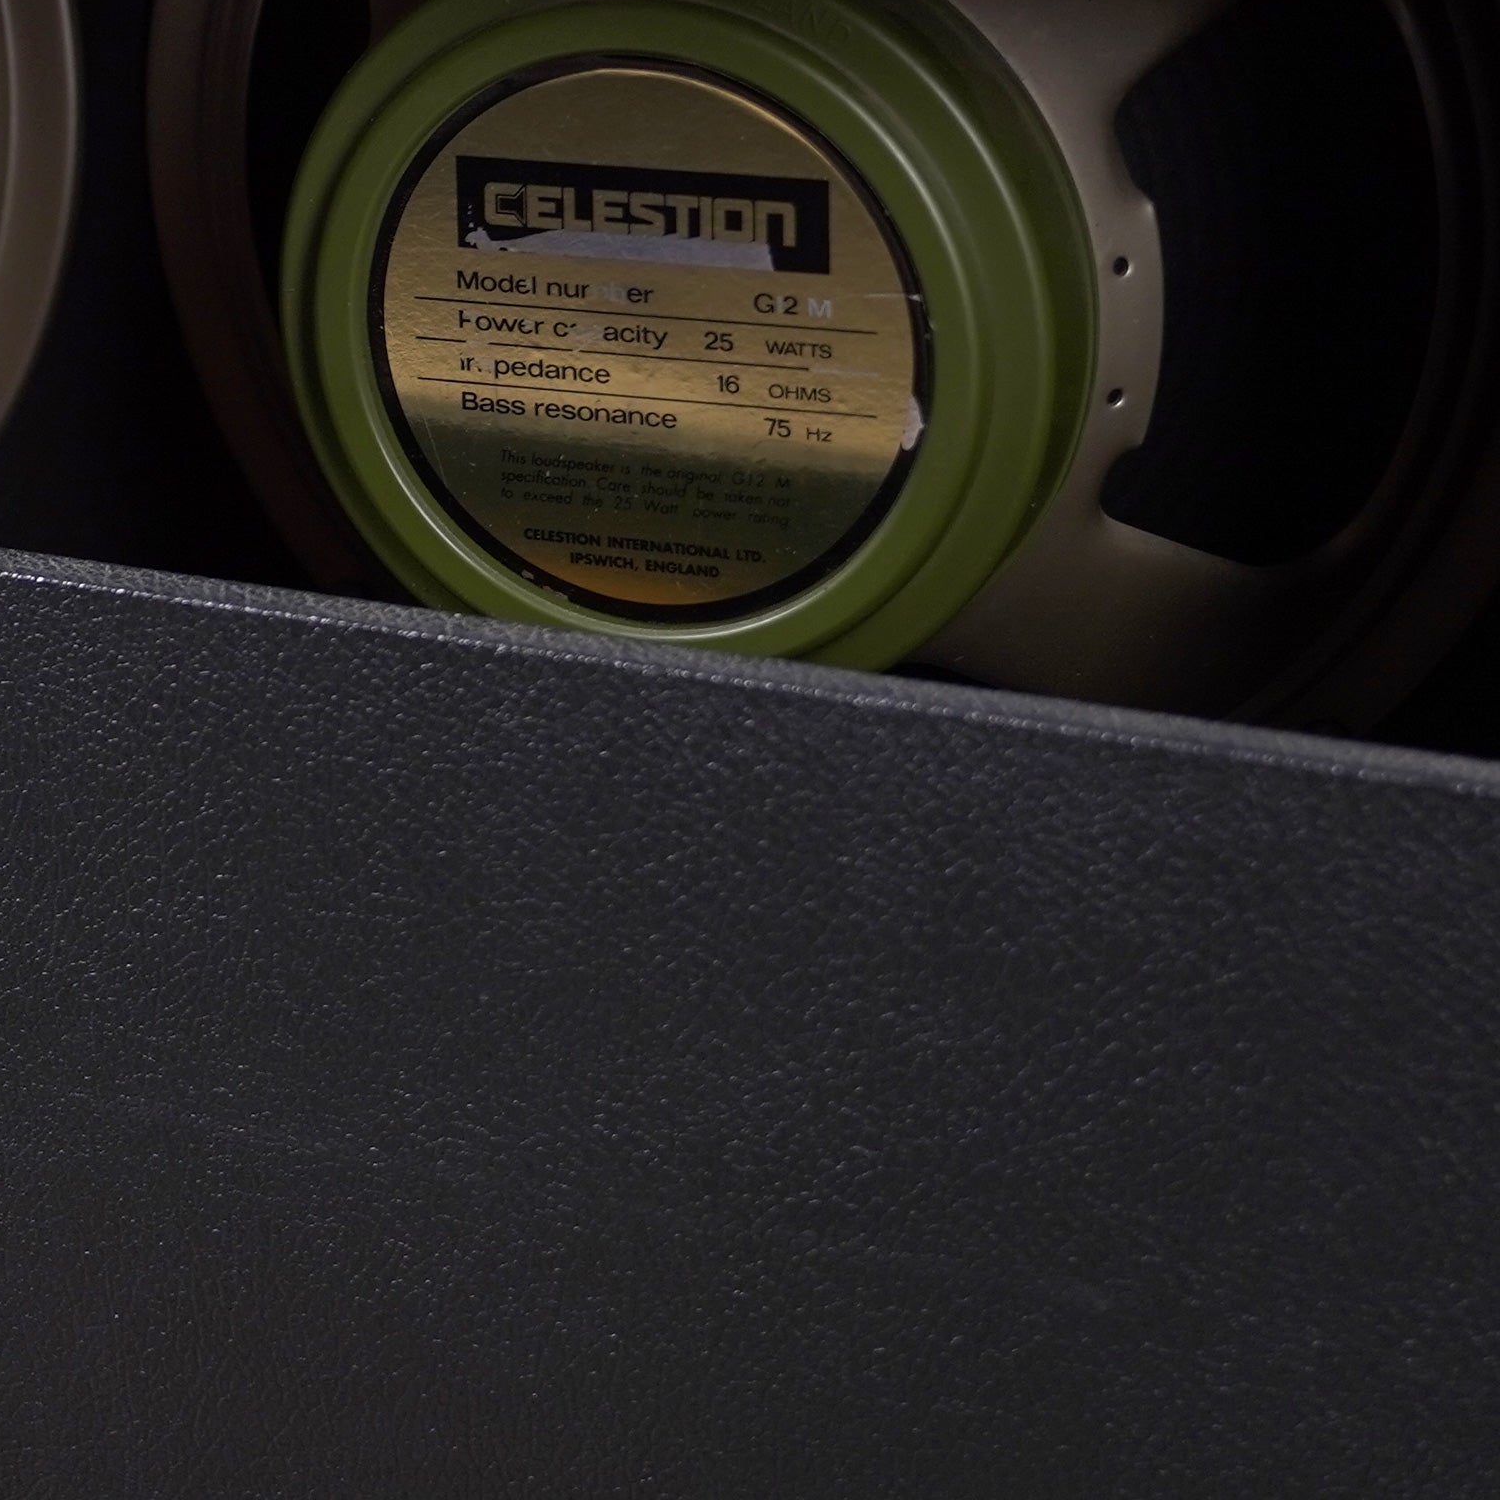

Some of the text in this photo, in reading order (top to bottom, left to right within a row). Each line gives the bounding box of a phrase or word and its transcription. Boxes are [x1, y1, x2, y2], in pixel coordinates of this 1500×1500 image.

[483, 180, 797, 248] CELESTION
[455, 269, 537, 296] Model
[545, 279, 655, 305] nuer
[552, 318, 669, 351] cacity
[703, 330, 735, 353] 25
[765, 339, 833, 360] WATTS
[716, 373, 740, 395] 16
[766, 382, 833, 404] OHMS
[460, 390, 833, 444] Bass resonance 75 Hz
[531, 452, 615, 477] loudspeaker
[774, 476, 792, 491] M
[596, 476, 632, 494] Care
[641, 480, 687, 499] should
[523, 489, 574, 506] exceed
[613, 496, 633, 512] 25
[643, 499, 680, 517] Watt
[523, 527, 768, 565] CELESTION INTERNATIONAL LTD.
[569, 551, 722, 580] IPSWICH, ENGLAND
